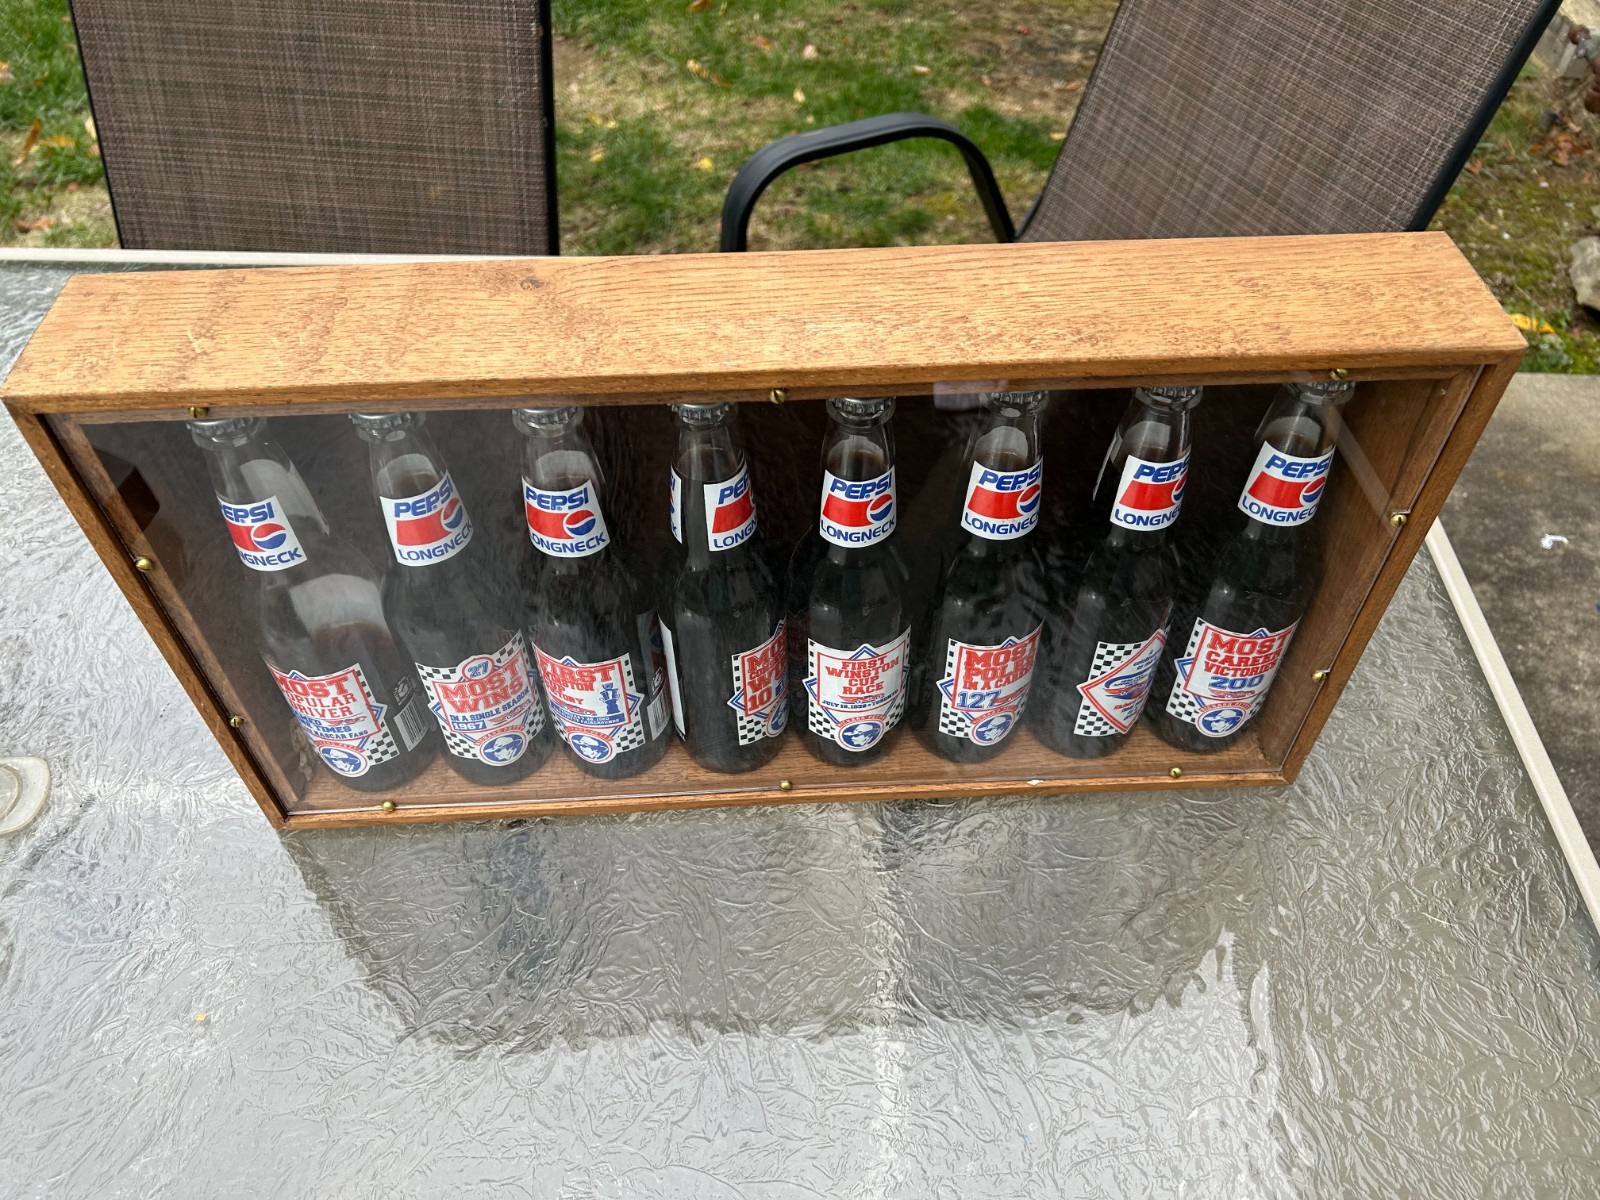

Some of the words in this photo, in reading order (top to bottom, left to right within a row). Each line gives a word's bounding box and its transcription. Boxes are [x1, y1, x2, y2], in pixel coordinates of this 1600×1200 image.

[978, 463, 1042, 491] PEPS
[1133, 454, 1190, 482] PEPS
[394, 475, 454, 518] PEPSI
[718, 470, 750, 505] PEP
[830, 471, 893, 499] PEPSI
[525, 485, 589, 511] PEPSI
[1242, 495, 1318, 522] LONGNEC
[220, 501, 275, 524] EPSI
[964, 512, 1039, 535] LONGNEC
[1114, 505, 1180, 526] LONGNE
[398, 519, 473, 561] LONGNECK
[713, 515, 757, 548] LONGN
[821, 515, 895, 543] LONGNECK
[240, 546, 303, 567] NGNECK
[746, 636, 785, 674] MO
[1207, 631, 1289, 656] MOST
[824, 655, 900, 679] WINSTON
[841, 655, 887, 670] FIRST
[1205, 647, 1283, 667] CAREER
[439, 655, 520, 699] MOST
[467, 660, 489, 679] 27
[848, 675, 880, 687] CUP
[1207, 673, 1265, 689] 200
[447, 675, 525, 713] WINS
[842, 680, 884, 695] RACE
[963, 680, 979, 690] IN
[981, 680, 992, 690] A
[286, 691, 358, 708] OPULAR
[470, 707, 502, 721] SINGLE
[502, 686, 530, 712] SEASON
[748, 685, 772, 711] 10
[822, 700, 840, 708] JULY
[956, 689, 1002, 709] 127
[453, 722, 485, 731] 1967
